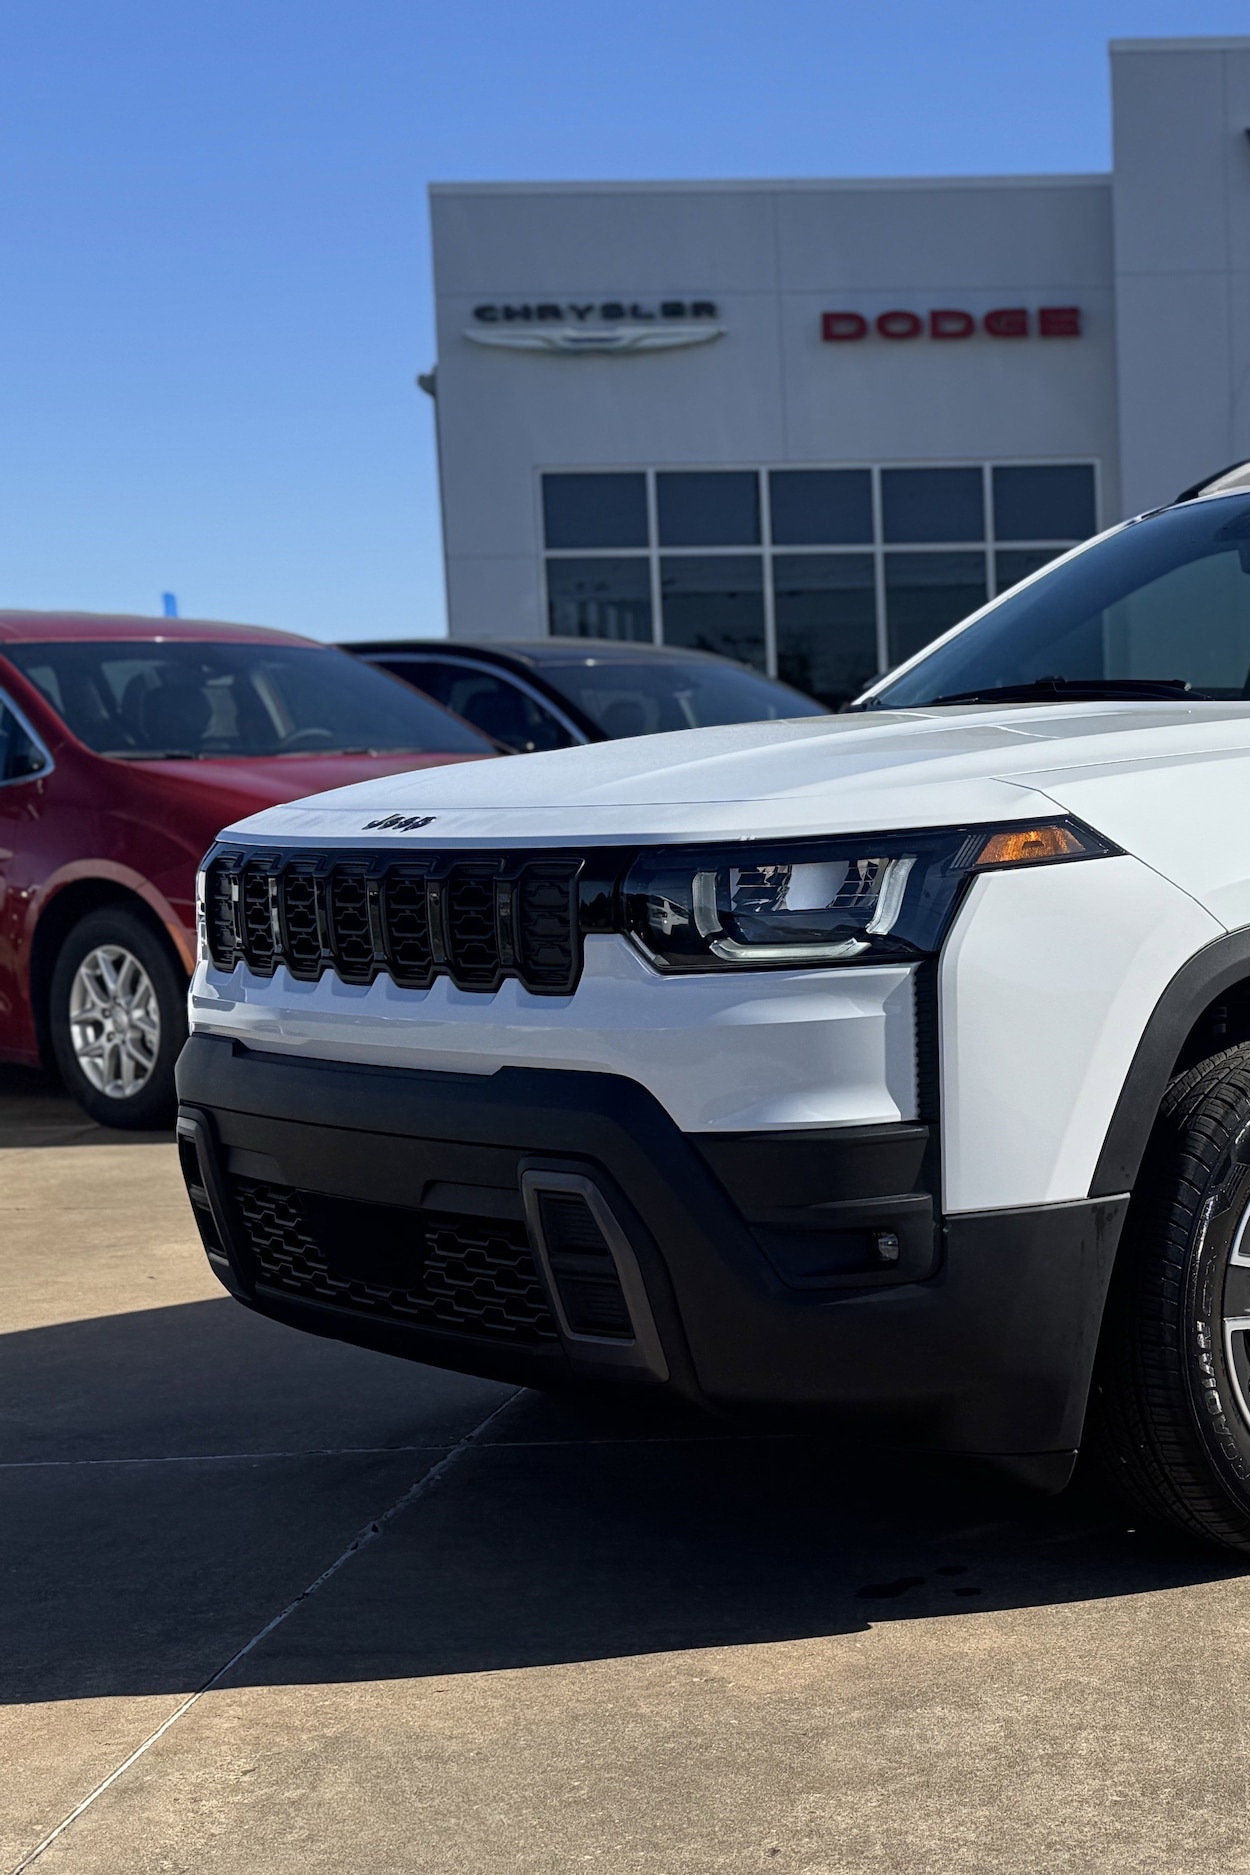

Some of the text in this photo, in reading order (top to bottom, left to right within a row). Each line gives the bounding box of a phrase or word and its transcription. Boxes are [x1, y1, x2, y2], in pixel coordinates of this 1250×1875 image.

[473, 300, 719, 323] CHRYSLER
[820, 307, 1083, 342] DODGE
[361, 813, 437, 833] Jeep
